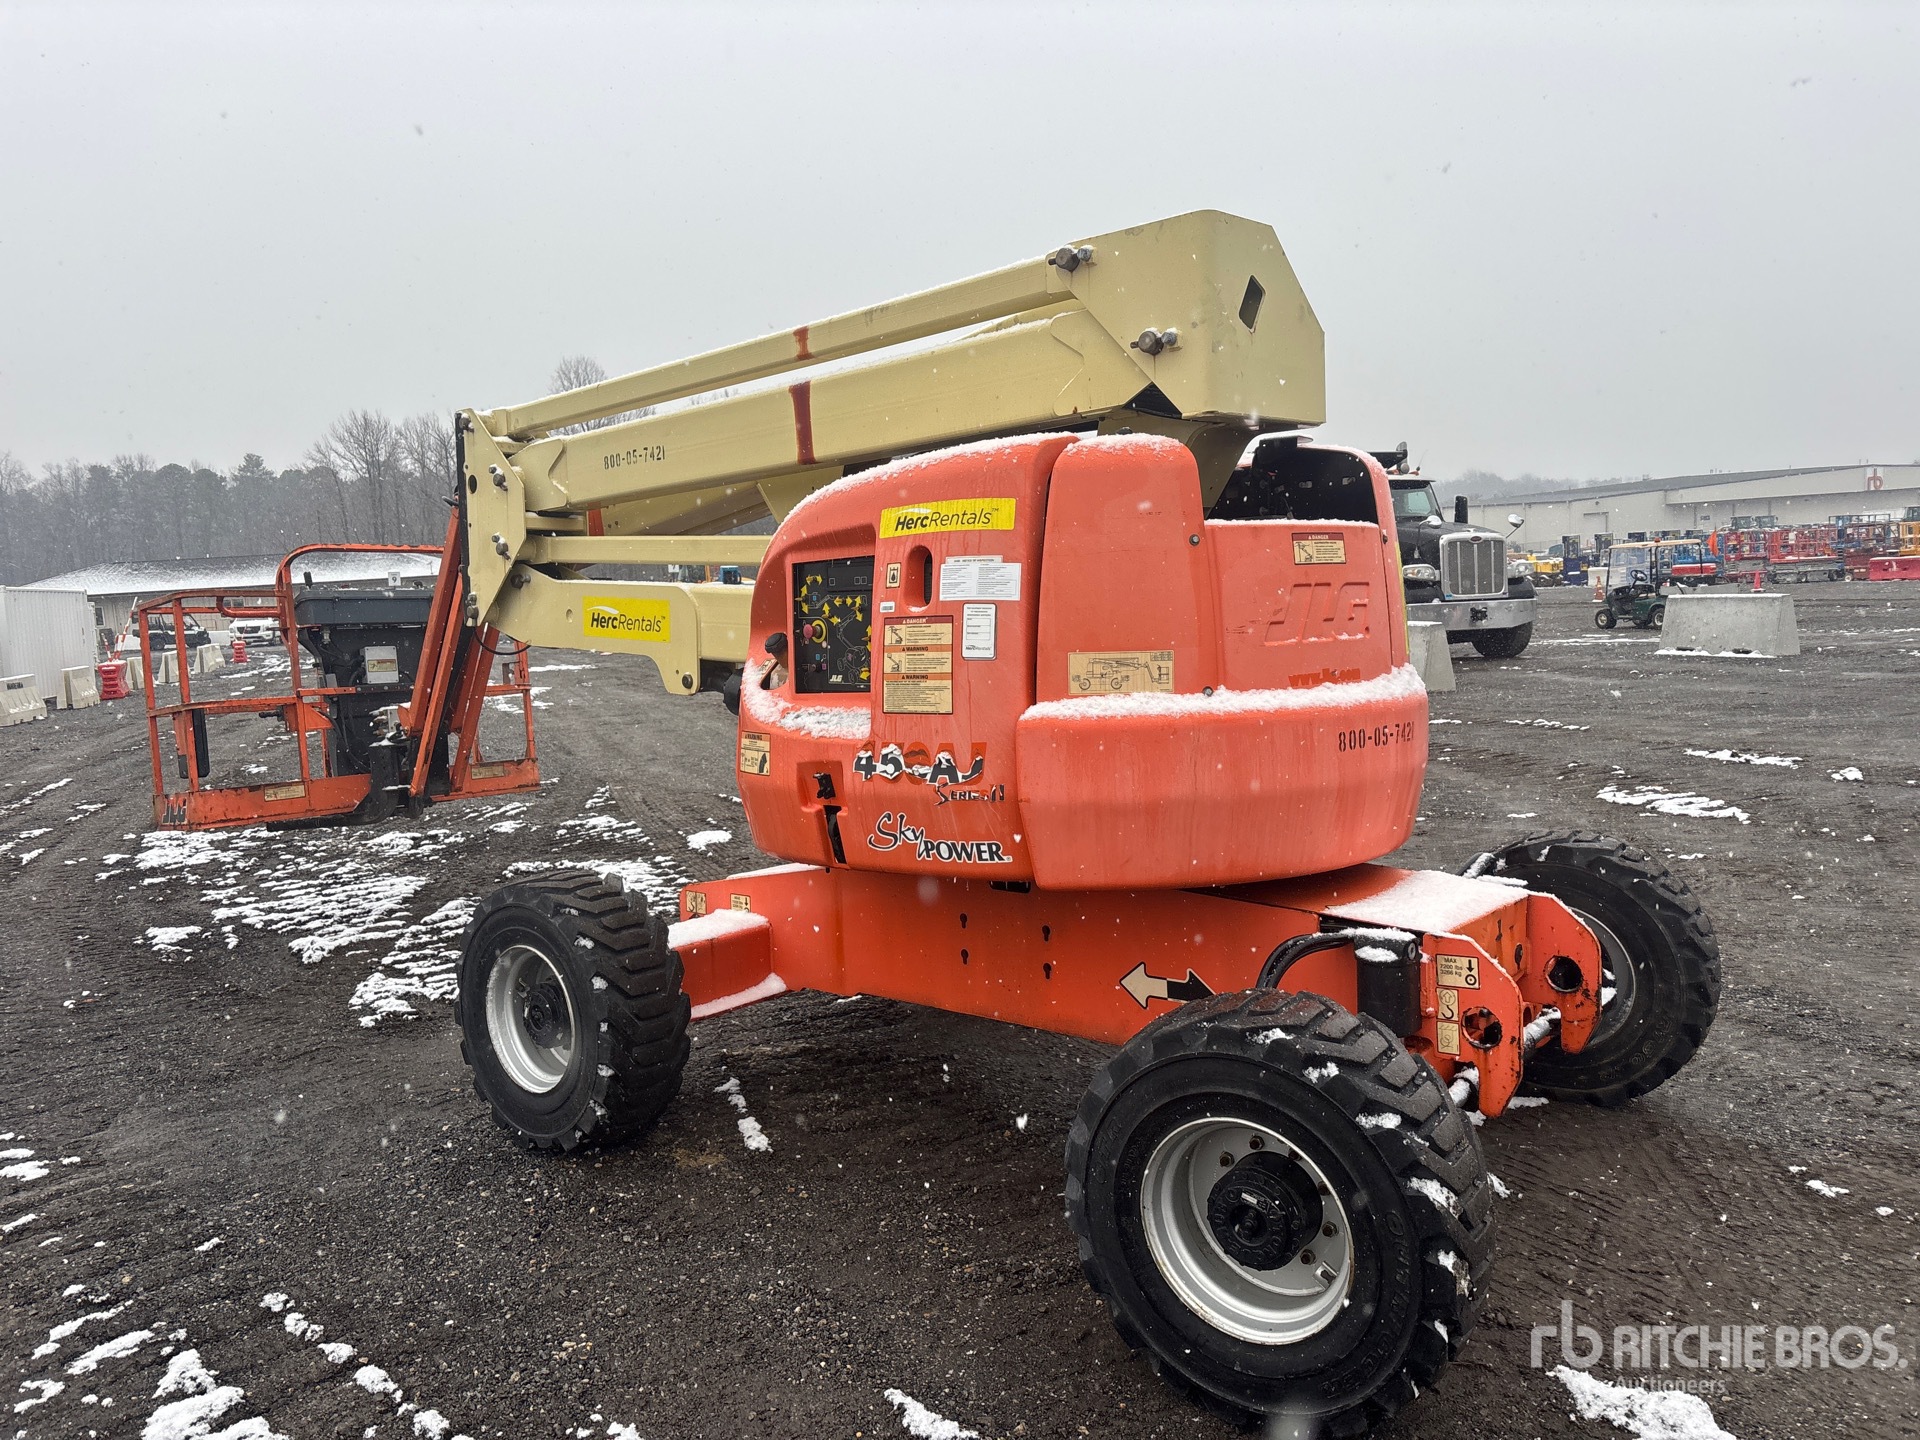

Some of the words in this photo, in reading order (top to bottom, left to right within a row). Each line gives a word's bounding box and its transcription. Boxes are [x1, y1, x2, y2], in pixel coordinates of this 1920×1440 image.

[603, 445, 665, 470] 800-05-7421
[895, 508, 992, 531] HercRentals
[590, 612, 662, 633] HercRentals
[1338, 720, 1415, 753] 800-05-7421
